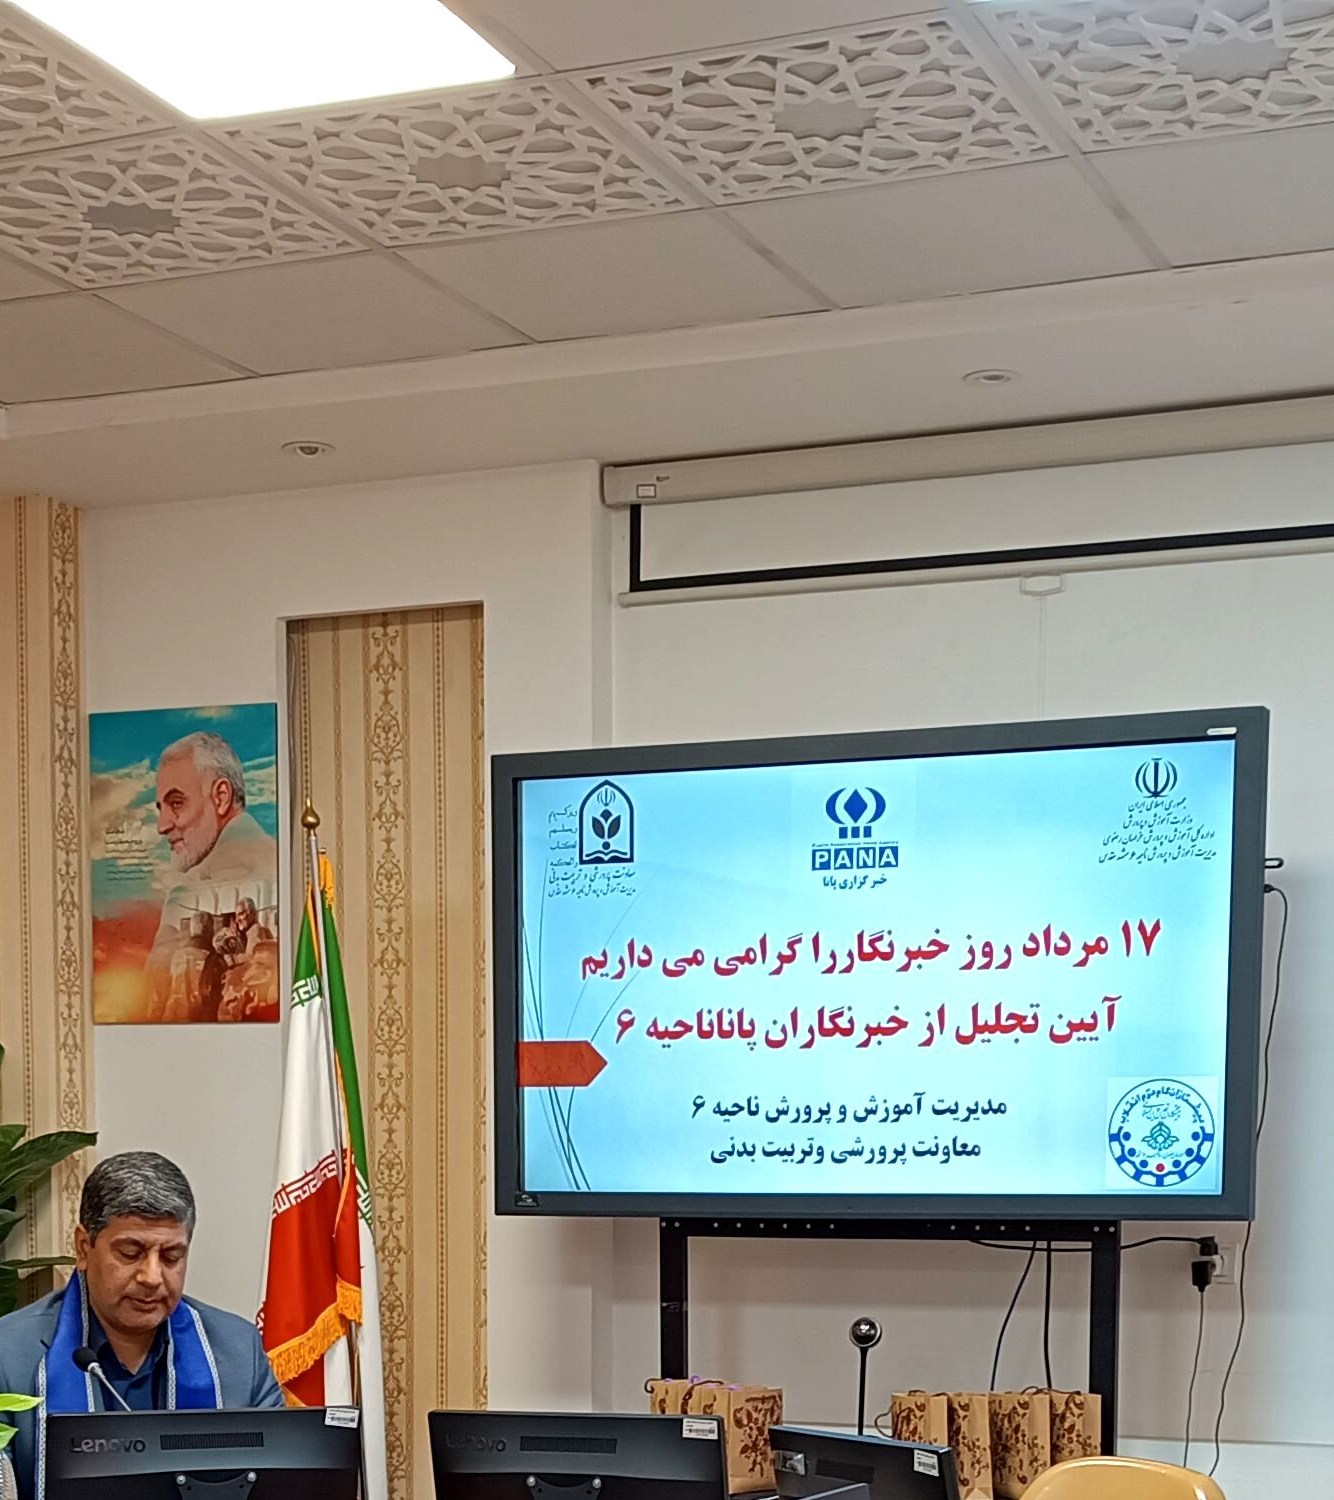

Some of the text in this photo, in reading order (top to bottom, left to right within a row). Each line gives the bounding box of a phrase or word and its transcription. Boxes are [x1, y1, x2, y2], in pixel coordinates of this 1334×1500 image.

[812, 846, 898, 870] PANA
[838, 875, 869, 890] گزاری
[870, 873, 888, 889] خبر
[713, 932, 804, 977] گرامی
[958, 934, 1012, 971] روز
[1022, 923, 1109, 968] مرداد
[1122, 918, 1161, 957] ۱۷
[581, 937, 653, 981] داریم
[662, 948, 705, 978] می
[615, 1008, 636, 1044] ۶
[764, 1004, 909, 1049] خبرنگاران
[918, 1003, 945, 1047] از
[954, 1001, 1040, 1045] تجلیل
[1049, 994, 1122, 1044] آیین
[691, 1091, 1007, 1124] مدیریت آموزش و پرورش ناحیه ۶
[710, 1135, 757, 1164] بدنی
[830, 1136, 906, 1165] پرورشی
[912, 1135, 981, 1164] معاونت
[69, 1437, 147, 1453] Lenovo
